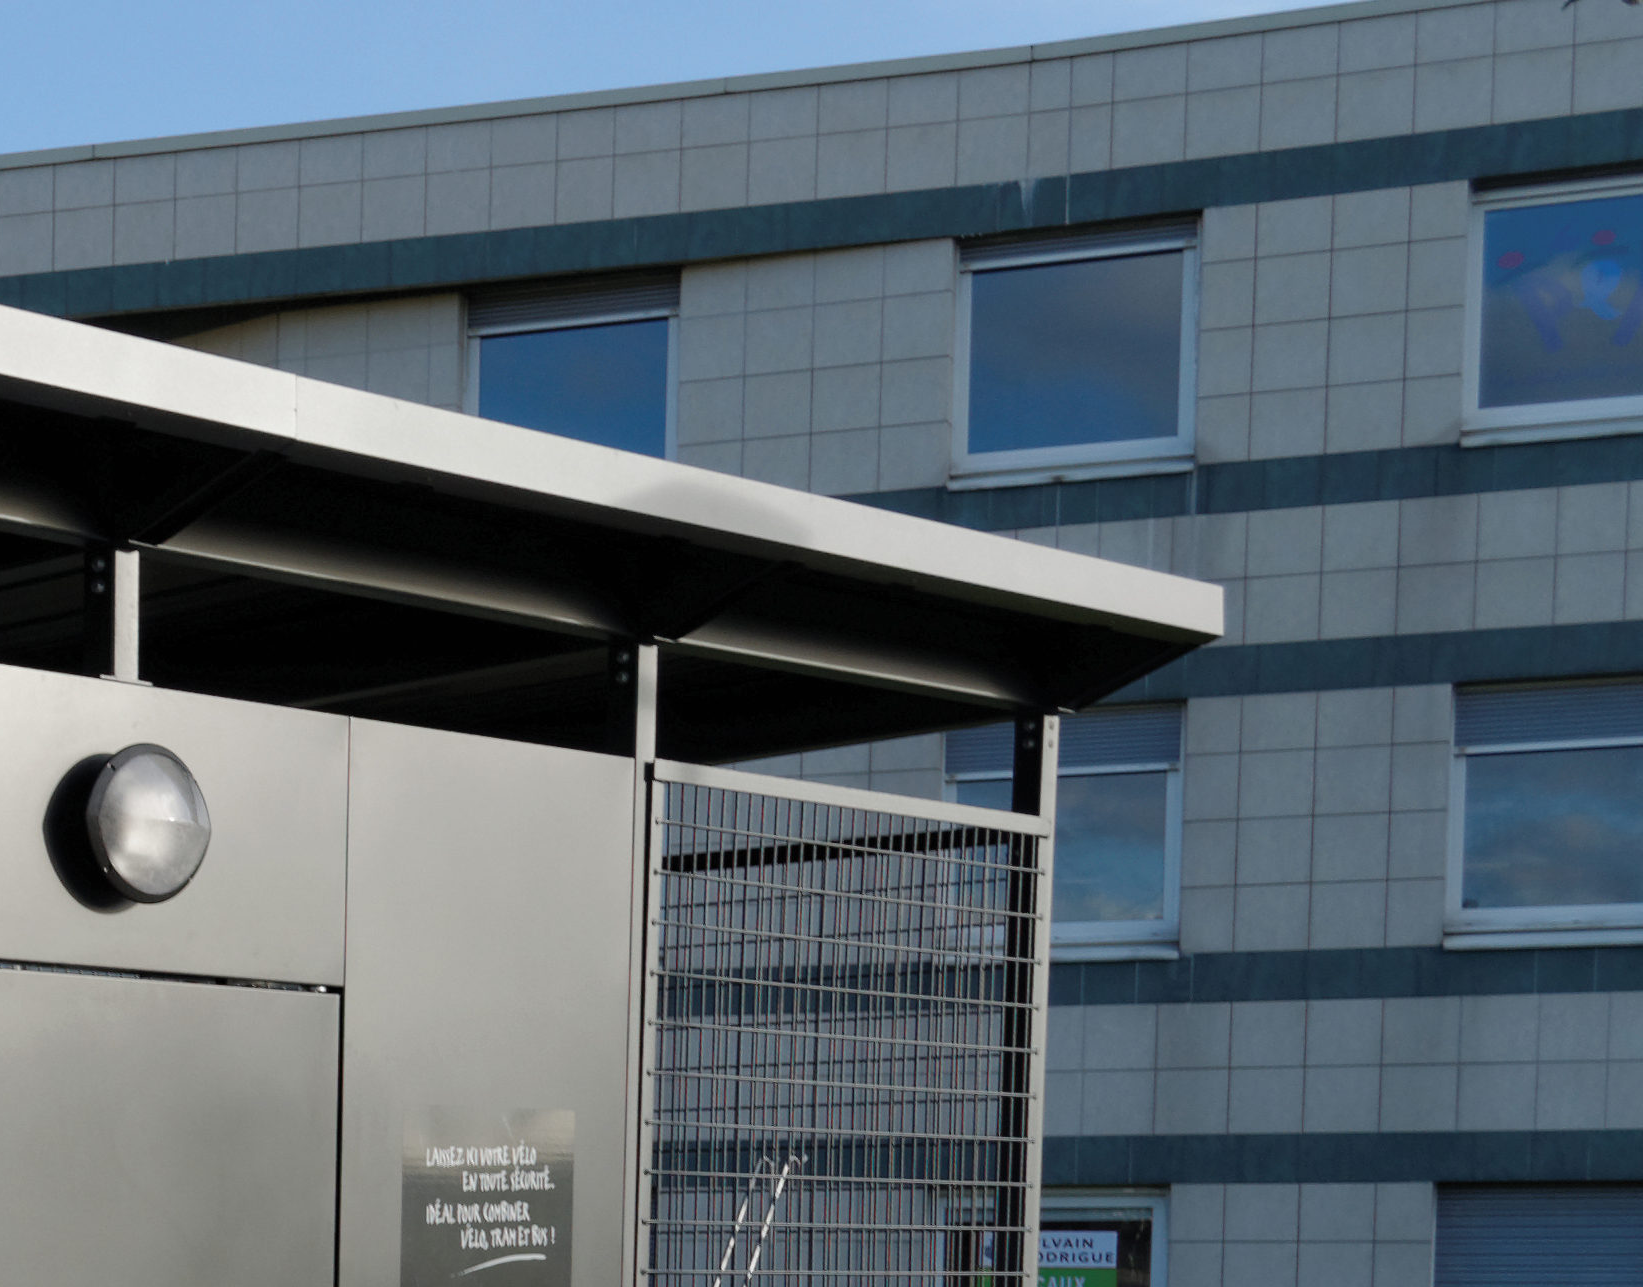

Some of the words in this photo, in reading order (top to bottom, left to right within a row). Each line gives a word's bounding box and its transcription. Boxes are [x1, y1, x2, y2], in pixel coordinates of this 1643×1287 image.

[426, 1147, 464, 1168] LAISSEZ
[466, 1147, 479, 1166] ICI
[480, 1145, 511, 1166] VOTRE
[512, 1140, 537, 1166] VÉLO
[462, 1170, 478, 1192] EN
[479, 1169, 510, 1192] TOUTE
[510, 1165, 555, 1192] SÉCURITÉ.
[426, 1198, 456, 1225] IDÉAL
[457, 1202, 481, 1223] POUR
[482, 1199, 531, 1223] COMBINER
[489, 1226, 517, 1248] TRAM
[531, 1224, 548, 1247] BUS
[1039, 1237, 1094, 1249] LVAIN
